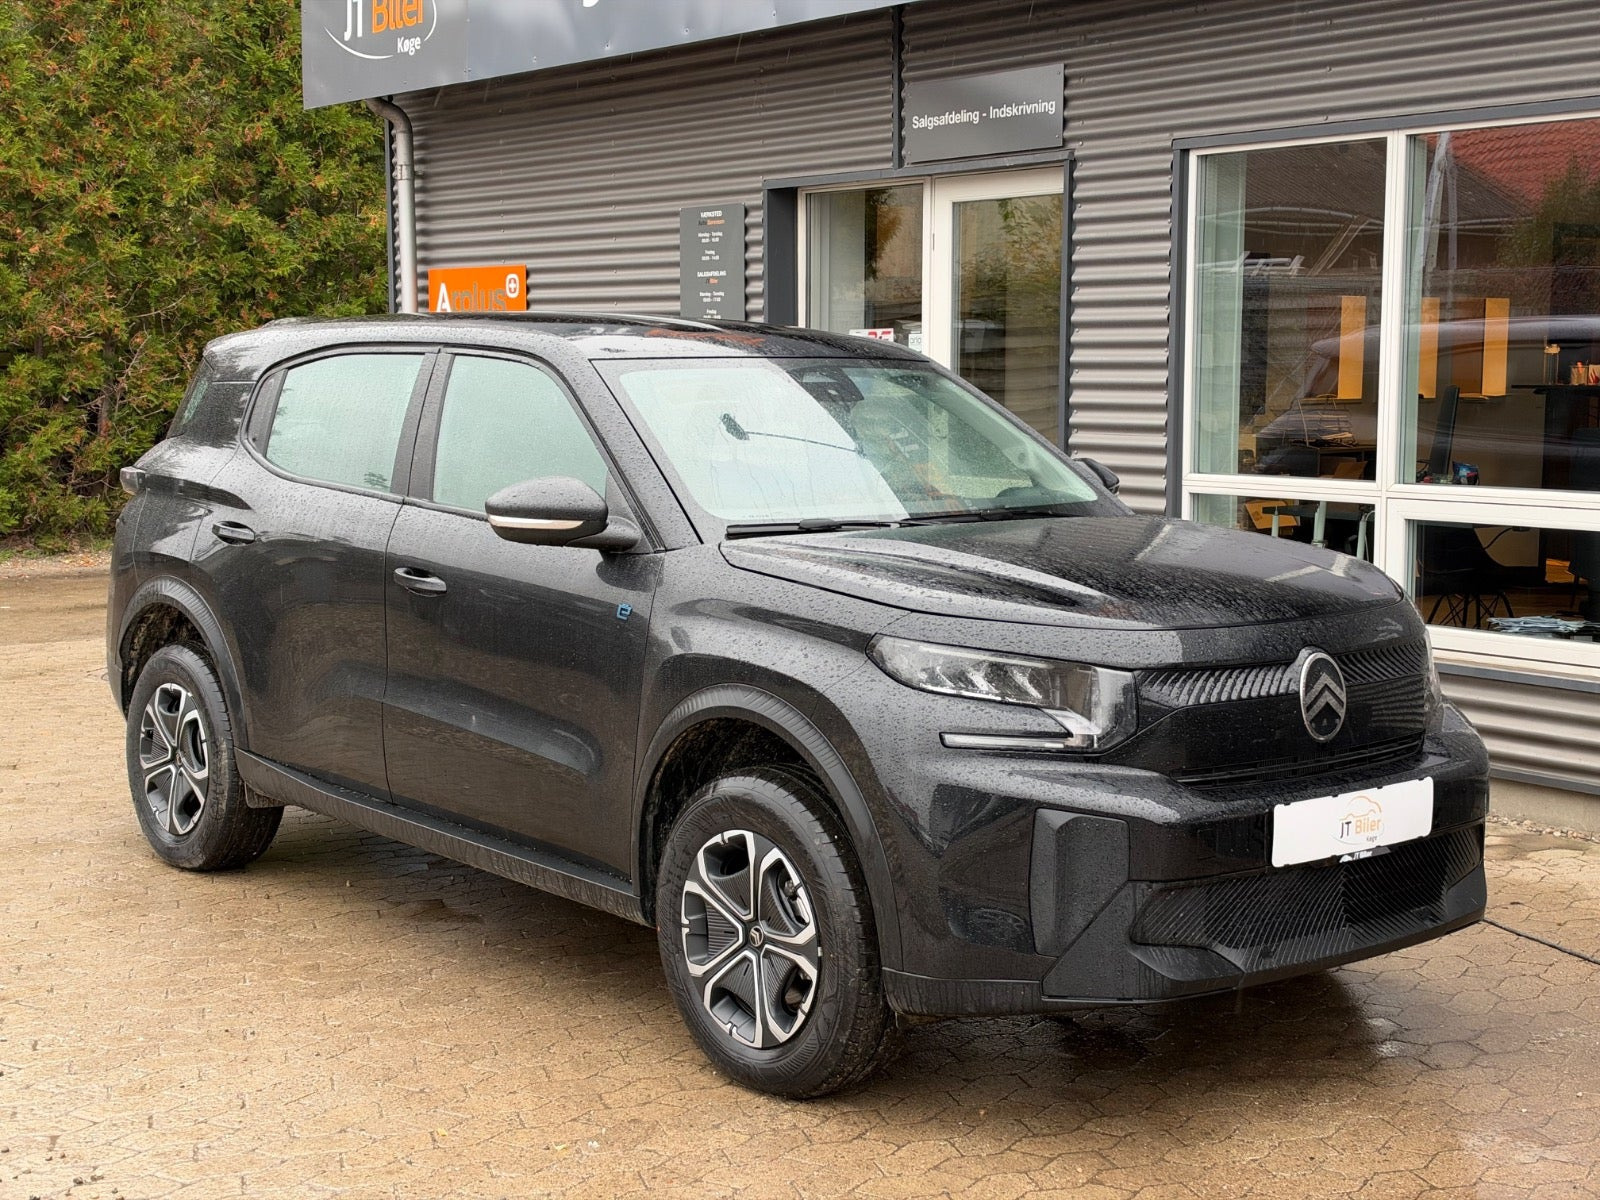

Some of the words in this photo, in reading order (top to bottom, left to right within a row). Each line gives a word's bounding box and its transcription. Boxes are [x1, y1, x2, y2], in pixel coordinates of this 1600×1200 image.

[397, 36, 422, 56] Køge
[912, 109, 980, 130] Salgsafdeling
[989, 100, 1056, 119] Indskrivning
[1340, 821, 1352, 839] JT
[1355, 817, 1381, 834] Biler
